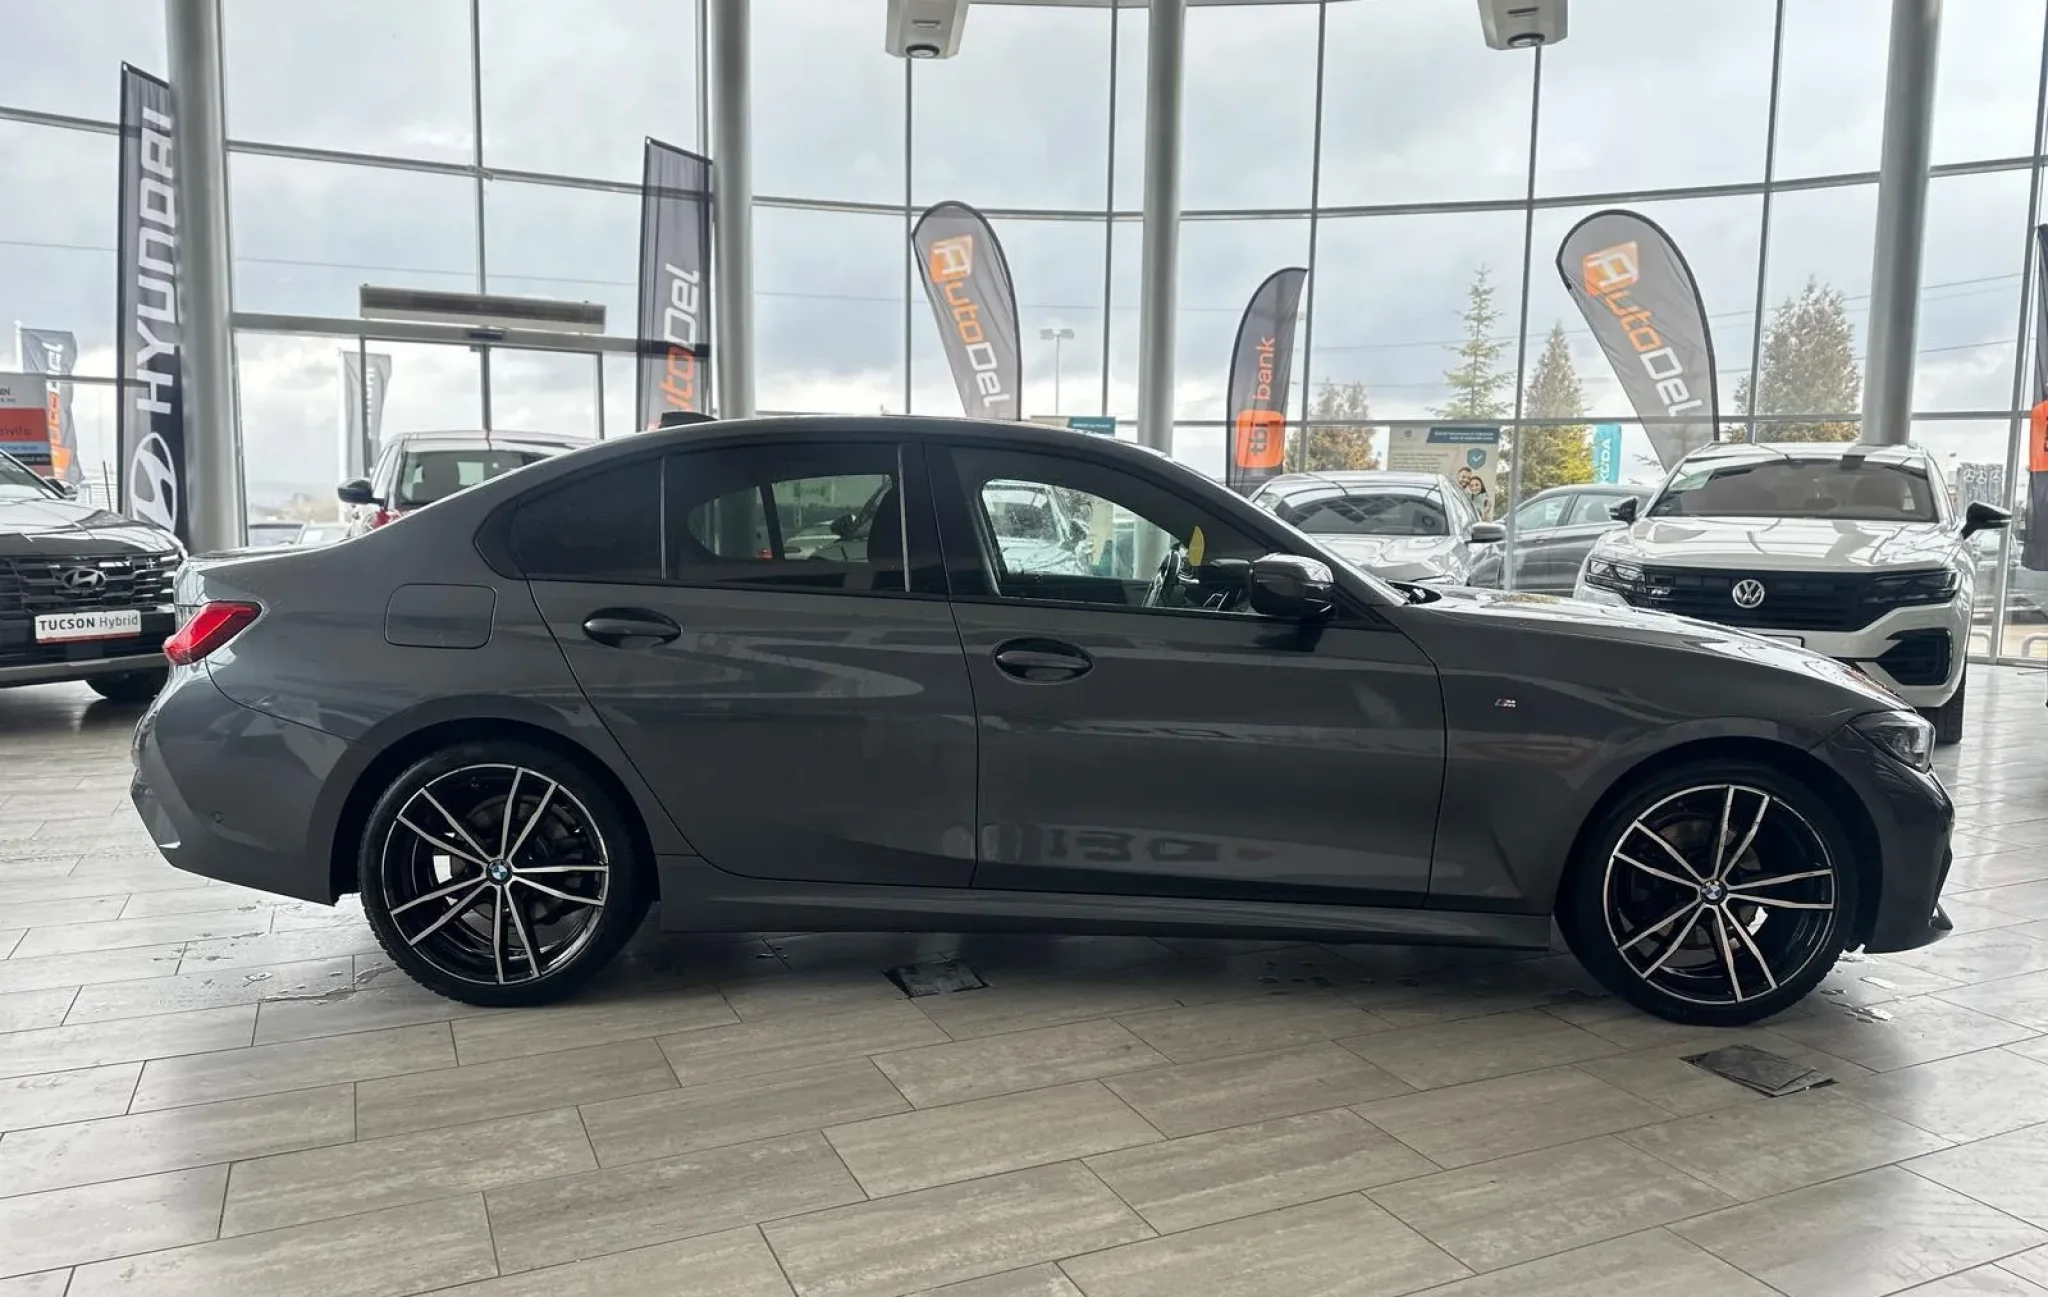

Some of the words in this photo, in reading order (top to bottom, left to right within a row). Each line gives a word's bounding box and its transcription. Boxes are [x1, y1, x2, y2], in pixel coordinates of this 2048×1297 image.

[136, 106, 175, 415] HYUNDAI
[648, 262, 699, 430] toDel
[1252, 336, 1275, 401] bank
[39, 617, 95, 631] TUCSON
[99, 613, 139, 629] Hybrid
